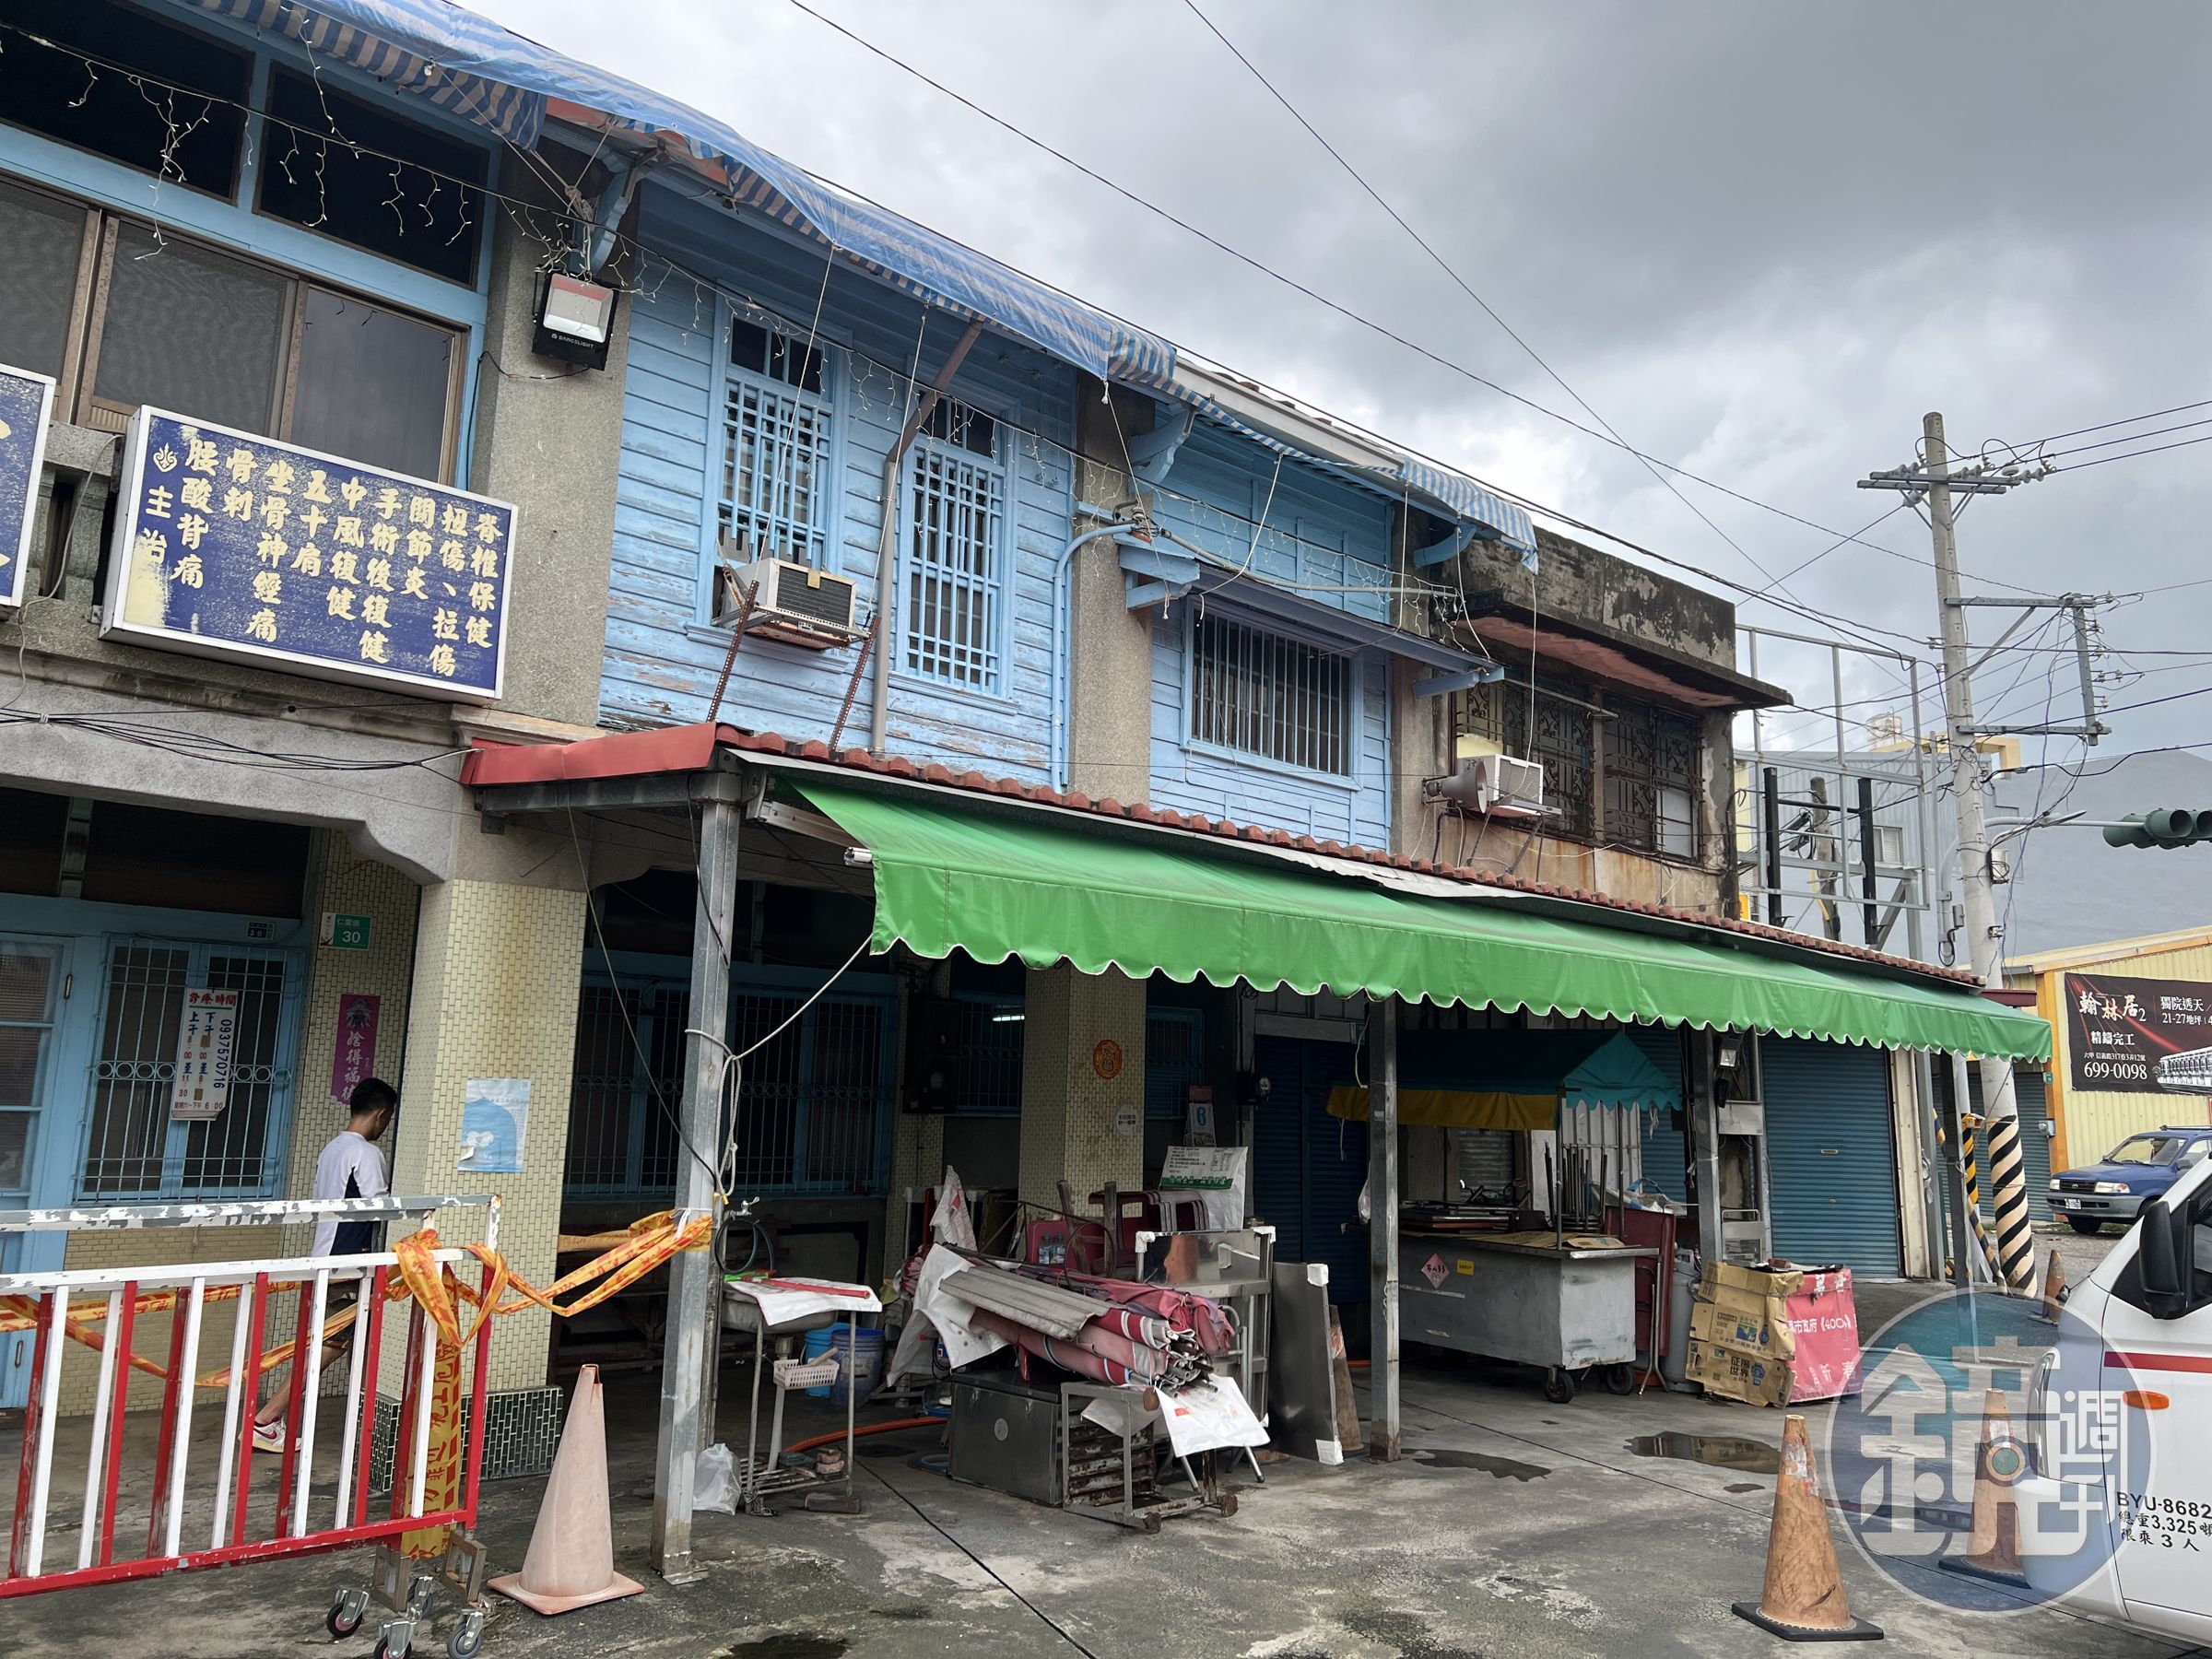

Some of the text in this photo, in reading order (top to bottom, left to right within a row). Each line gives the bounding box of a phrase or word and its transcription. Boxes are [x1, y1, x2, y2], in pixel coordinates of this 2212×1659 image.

[171, 438, 220, 589] 腰酸背痛
[222, 448, 259, 522] 骨刺
[290, 470, 333, 577] 五十肩
[141, 485, 174, 565] 主治
[245, 459, 296, 642] 坐骨神經痛
[326, 477, 368, 620] 中風復健
[359, 488, 403, 664] 手術後復健
[465, 513, 504, 648] 脊椎保健
[342, 930, 361, 944] 30
[190, 992, 237, 1007] 診療時間
[2160, 996, 2204, 1012] 獨院透天
[214, 1018, 232, 1088] 0937570716
[2084, 1062, 2147, 1080] 699-0098
[2116, 1490, 2212, 1520] BYU-8682
